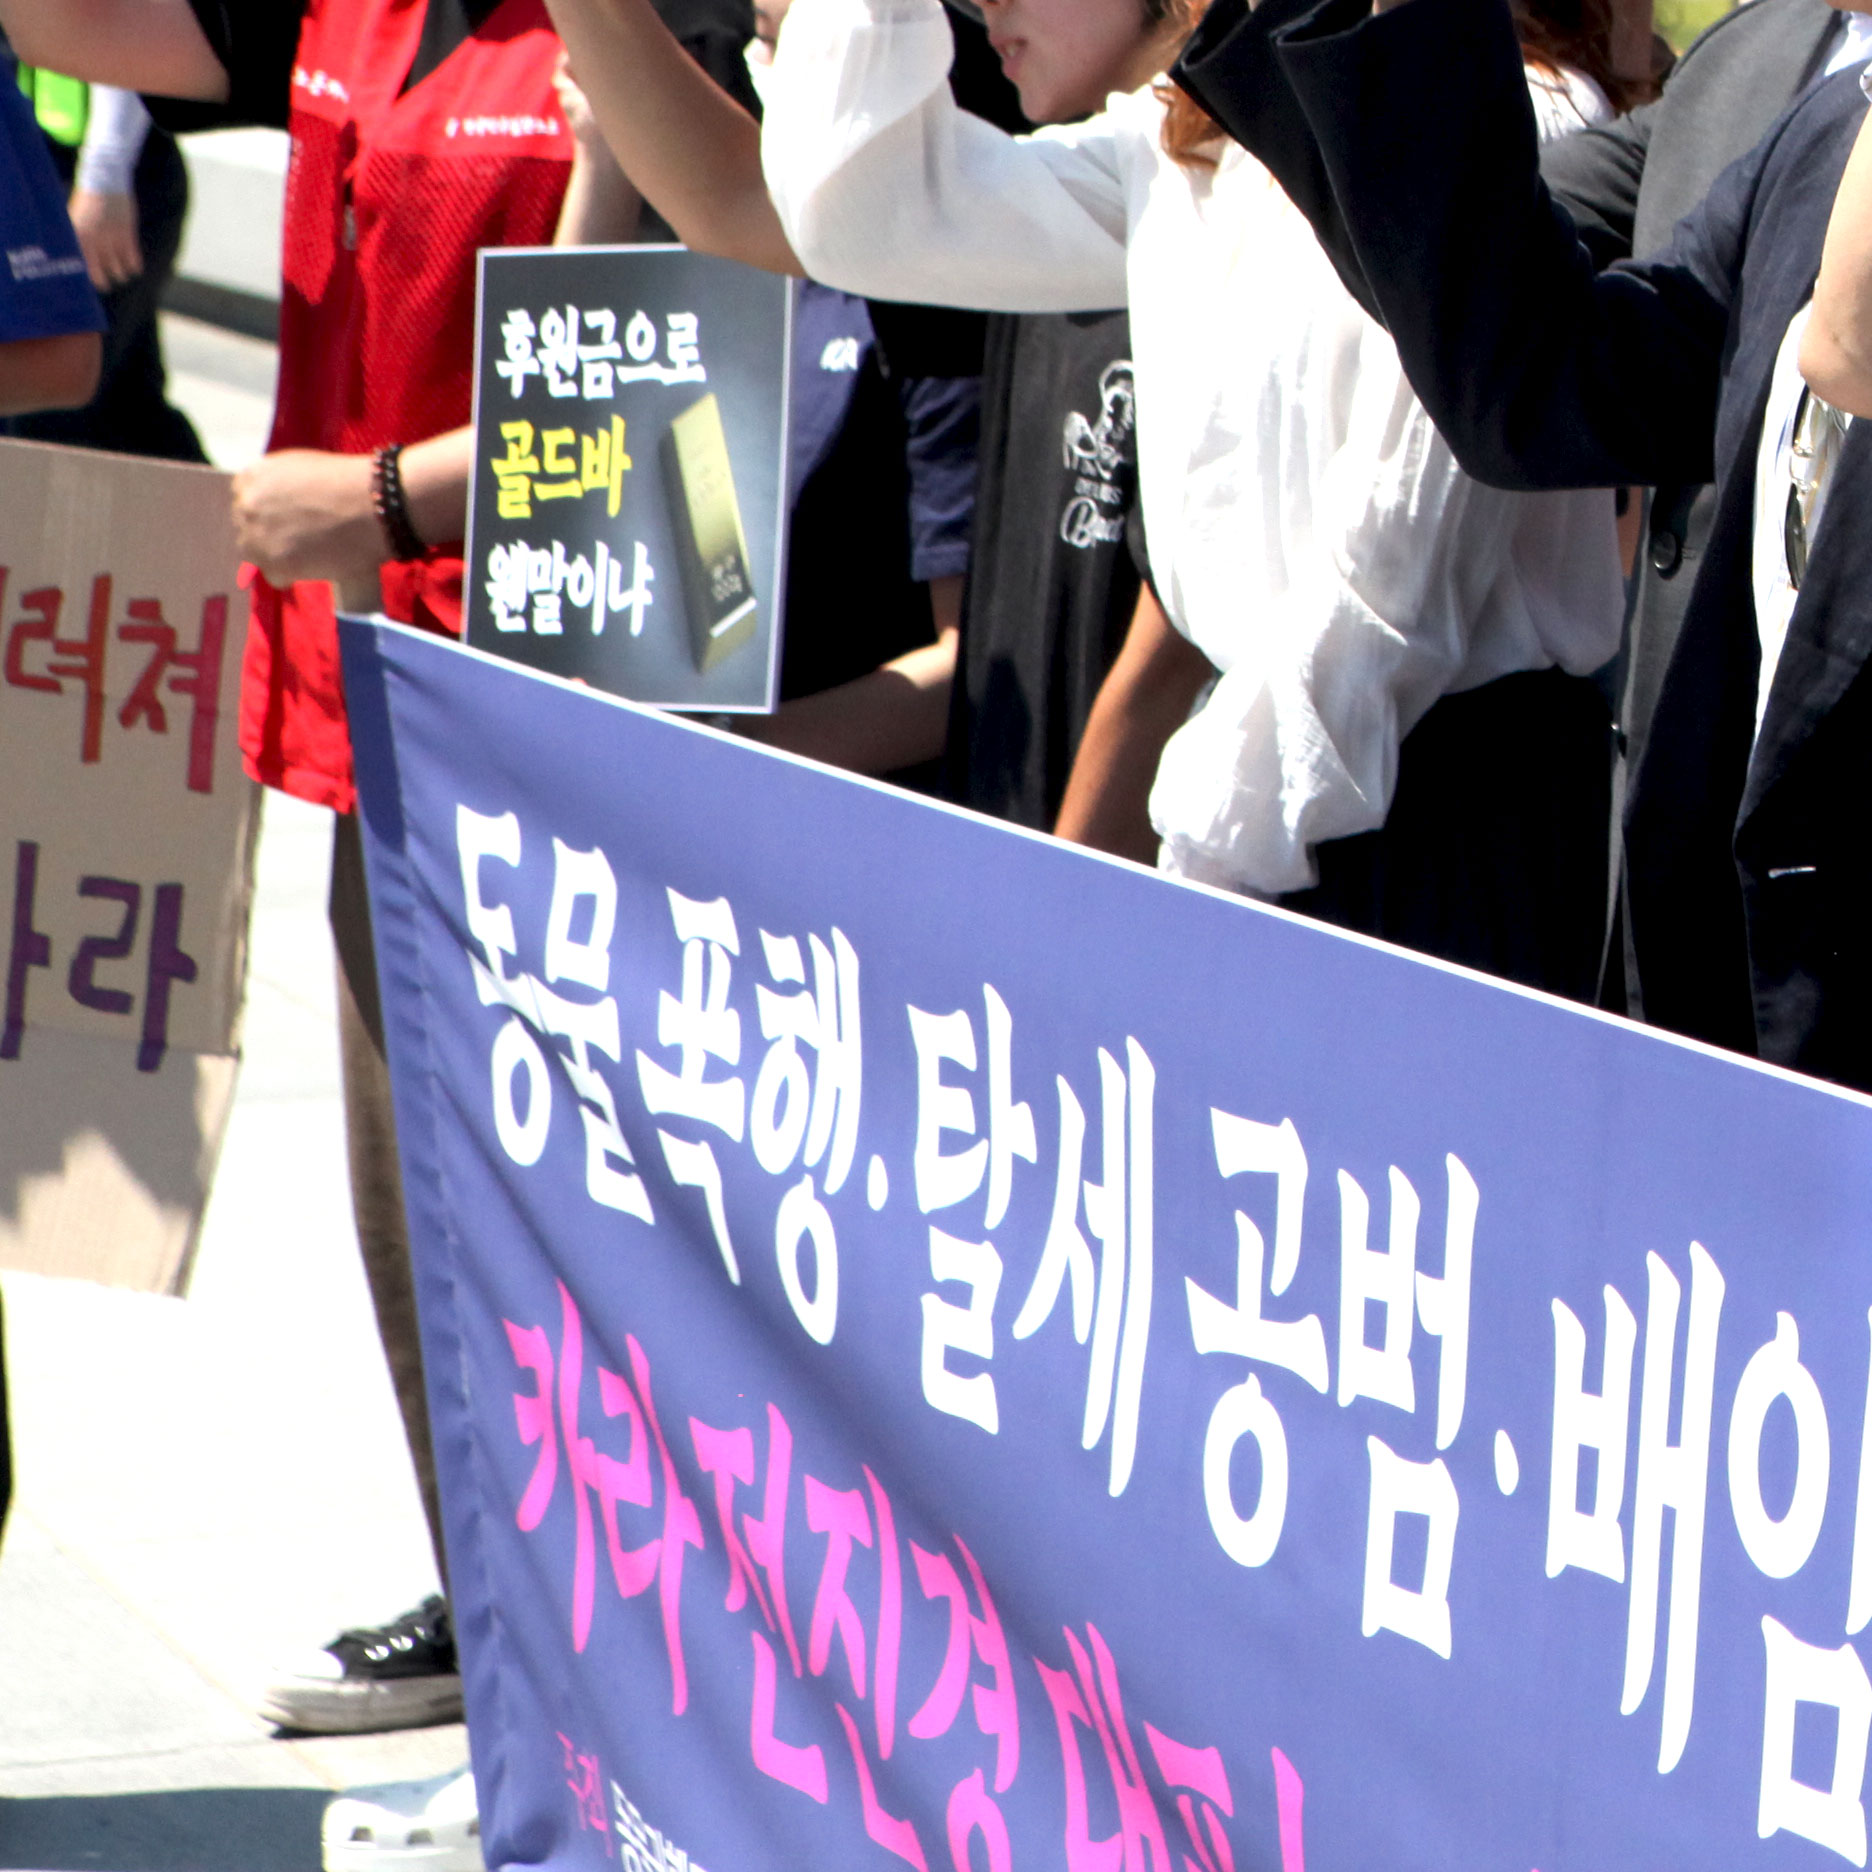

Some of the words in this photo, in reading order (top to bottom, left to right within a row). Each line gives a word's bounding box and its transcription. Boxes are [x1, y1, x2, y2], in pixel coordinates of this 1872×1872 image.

[495, 304, 707, 400] 후원금으로
[490, 414, 632, 519] 골드바
[485, 539, 654, 637] 웬말이냐
[0, 565, 229, 796] 려쳐
[503, 1277, 705, 1717] 카라
[687, 1400, 1020, 1872] 전진경
